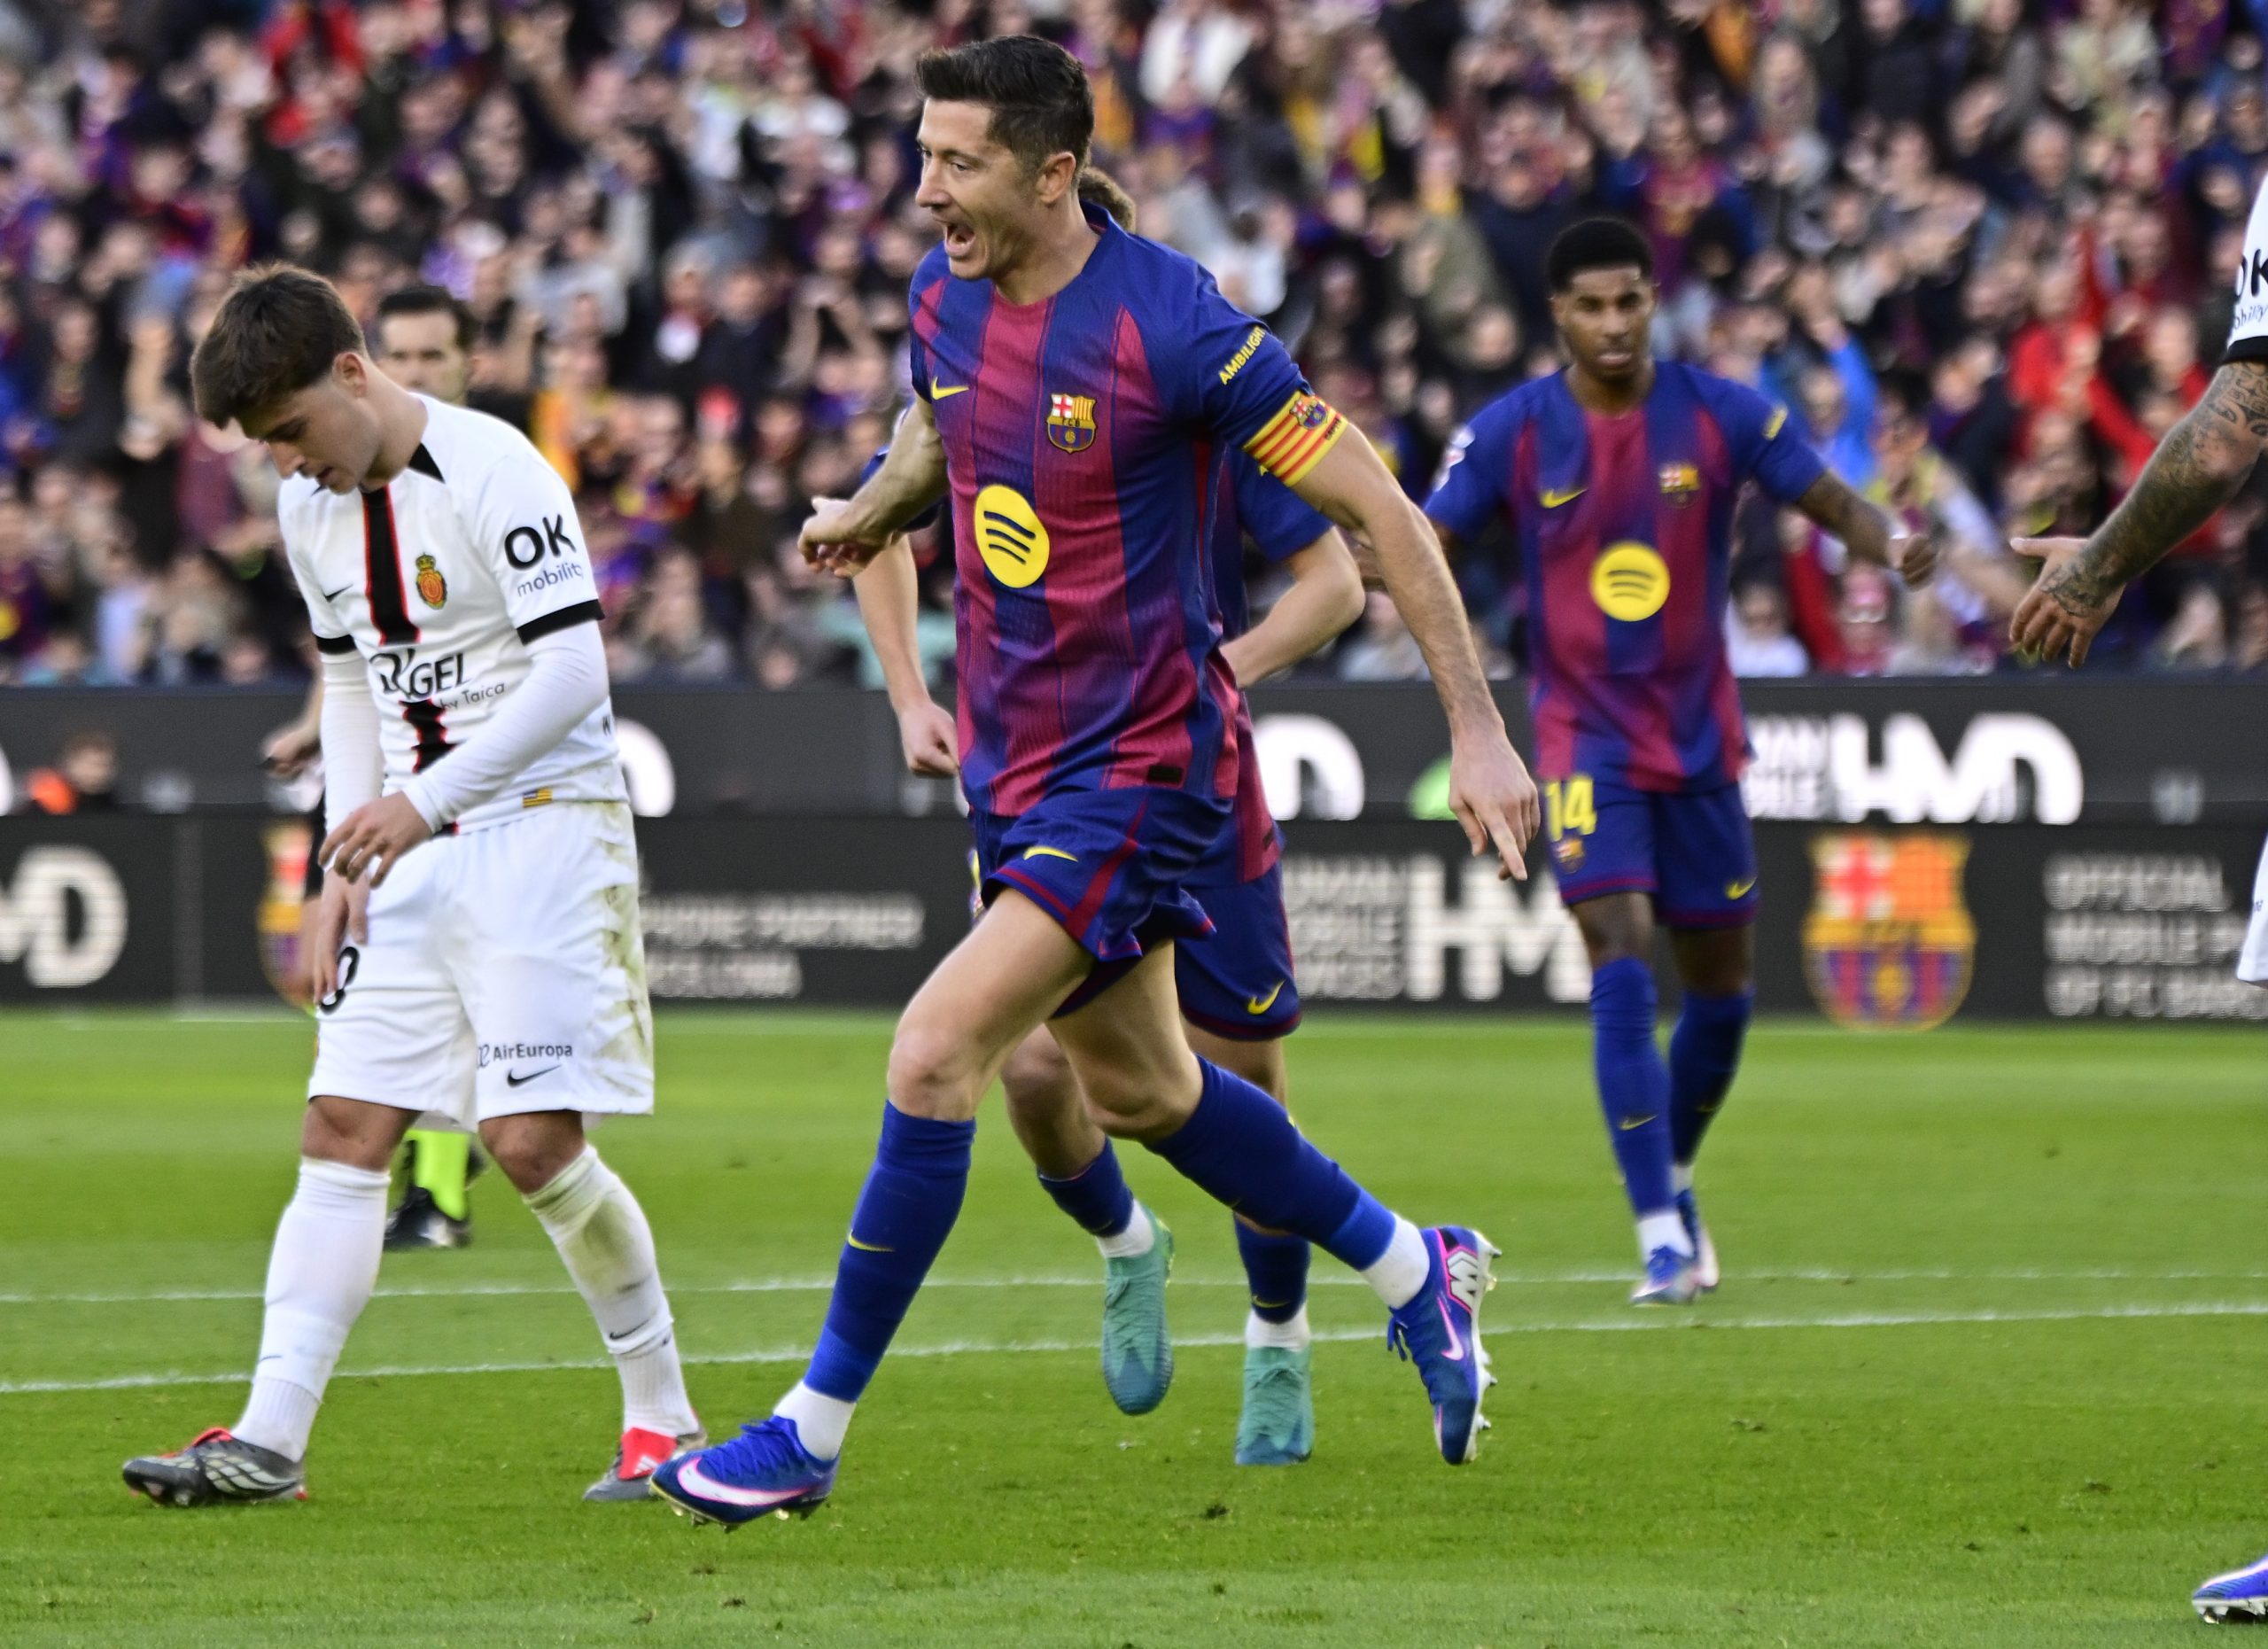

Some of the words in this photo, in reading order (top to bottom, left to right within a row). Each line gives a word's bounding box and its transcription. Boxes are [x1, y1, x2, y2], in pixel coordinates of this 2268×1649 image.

[504, 513, 577, 570] OK
[462, 682, 505, 705] Taica
[1545, 775, 1597, 842] 14
[493, 1044, 572, 1061] AirEuropa
